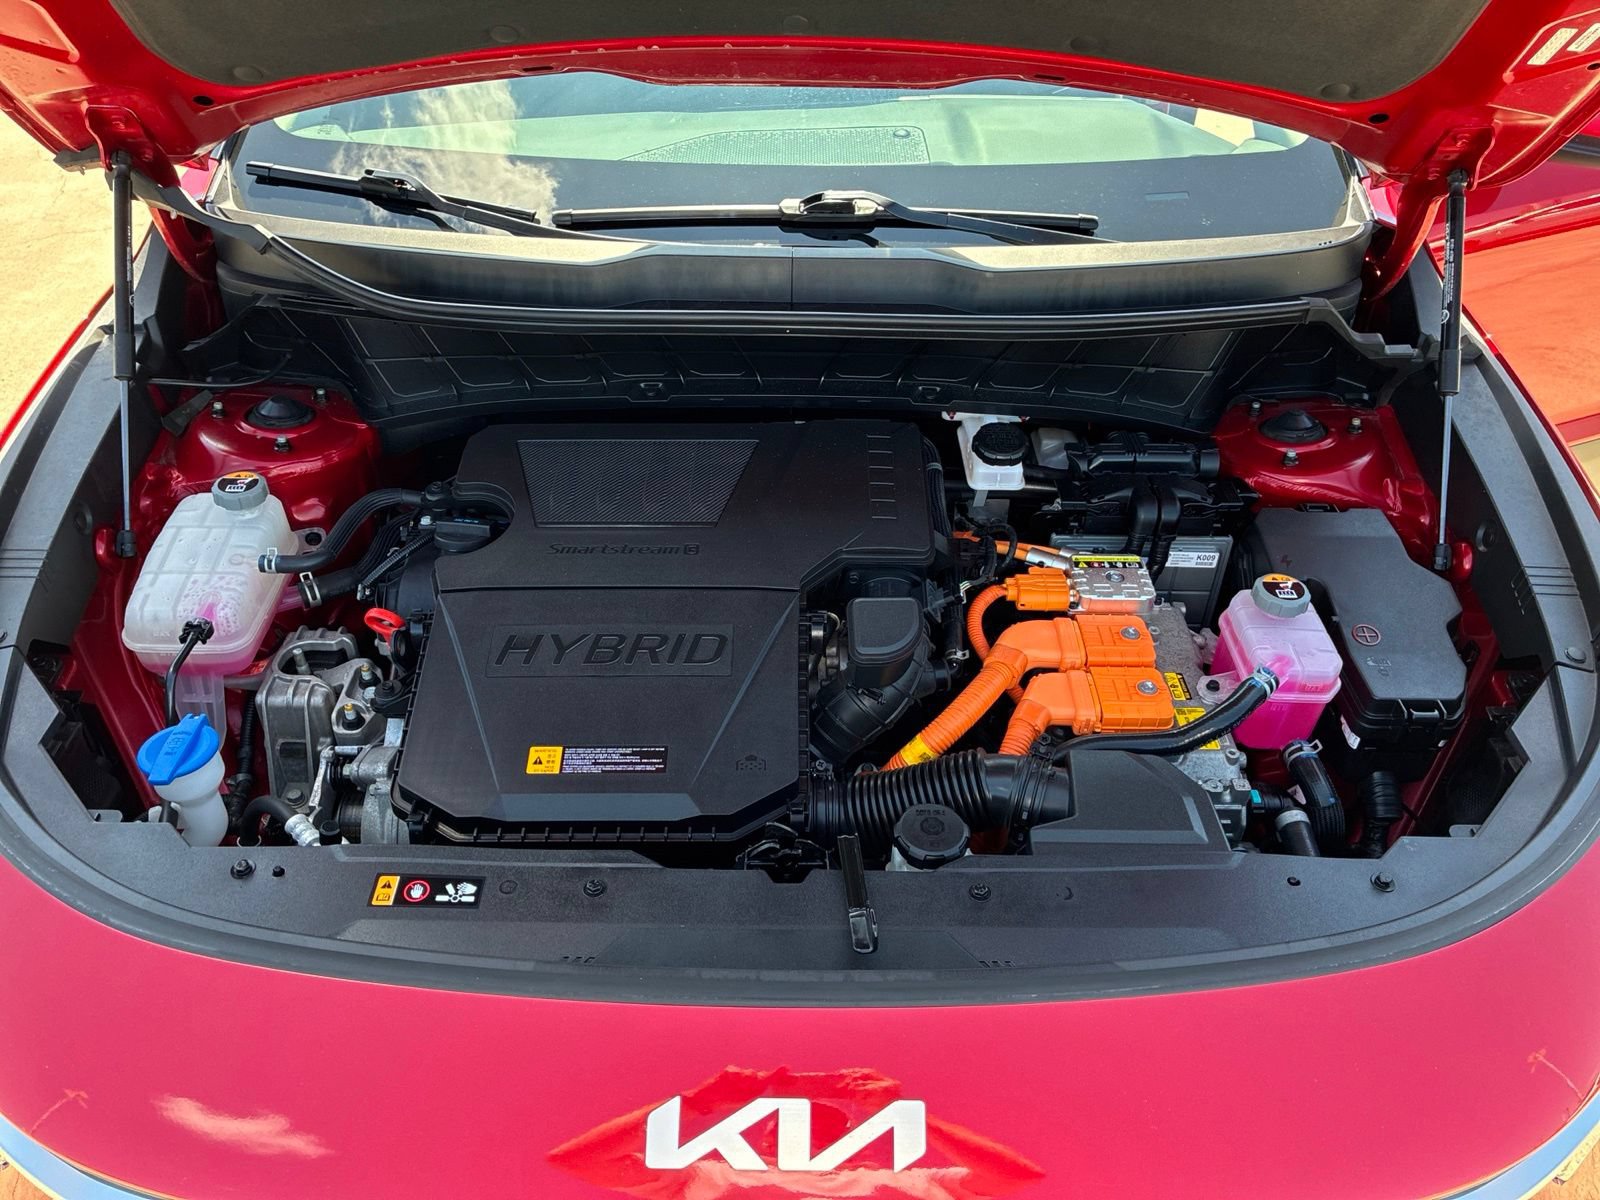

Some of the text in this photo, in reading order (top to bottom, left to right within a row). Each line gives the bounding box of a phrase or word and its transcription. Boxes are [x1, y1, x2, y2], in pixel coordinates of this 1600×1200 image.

[548, 543, 680, 555] Smartstream
[495, 633, 728, 666] HYBRID
[645, 1095, 927, 1173] KIA
